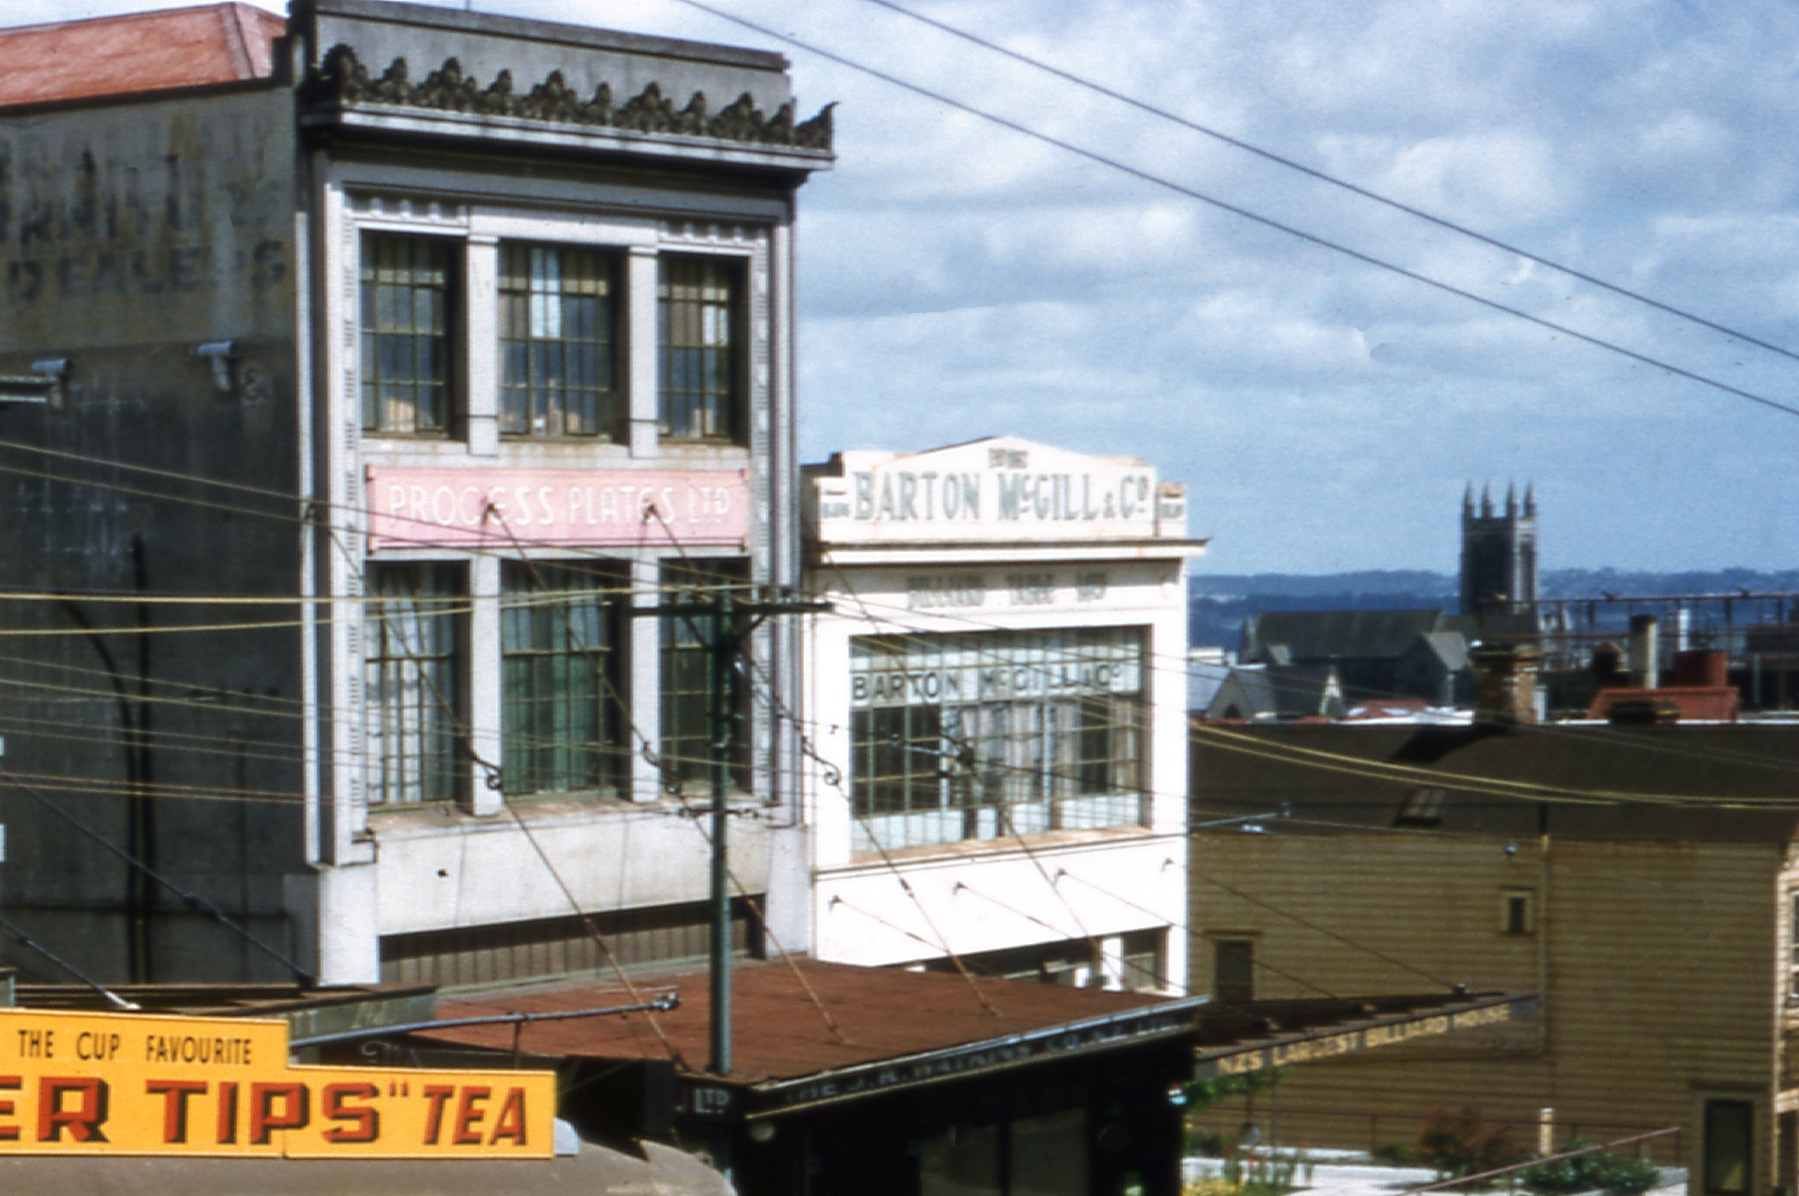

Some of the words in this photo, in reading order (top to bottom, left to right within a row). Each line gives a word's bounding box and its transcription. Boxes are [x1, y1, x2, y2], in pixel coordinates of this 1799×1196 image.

[388, 484, 555, 529] PROCESS
[853, 471, 981, 522] BARTON
[851, 671, 963, 701] BARTON
[17, 1028, 56, 1059] THE
[75, 1030, 122, 1061] CUP
[144, 1033, 255, 1066] FAVOURITE
[422, 1084, 530, 1147] TEA
